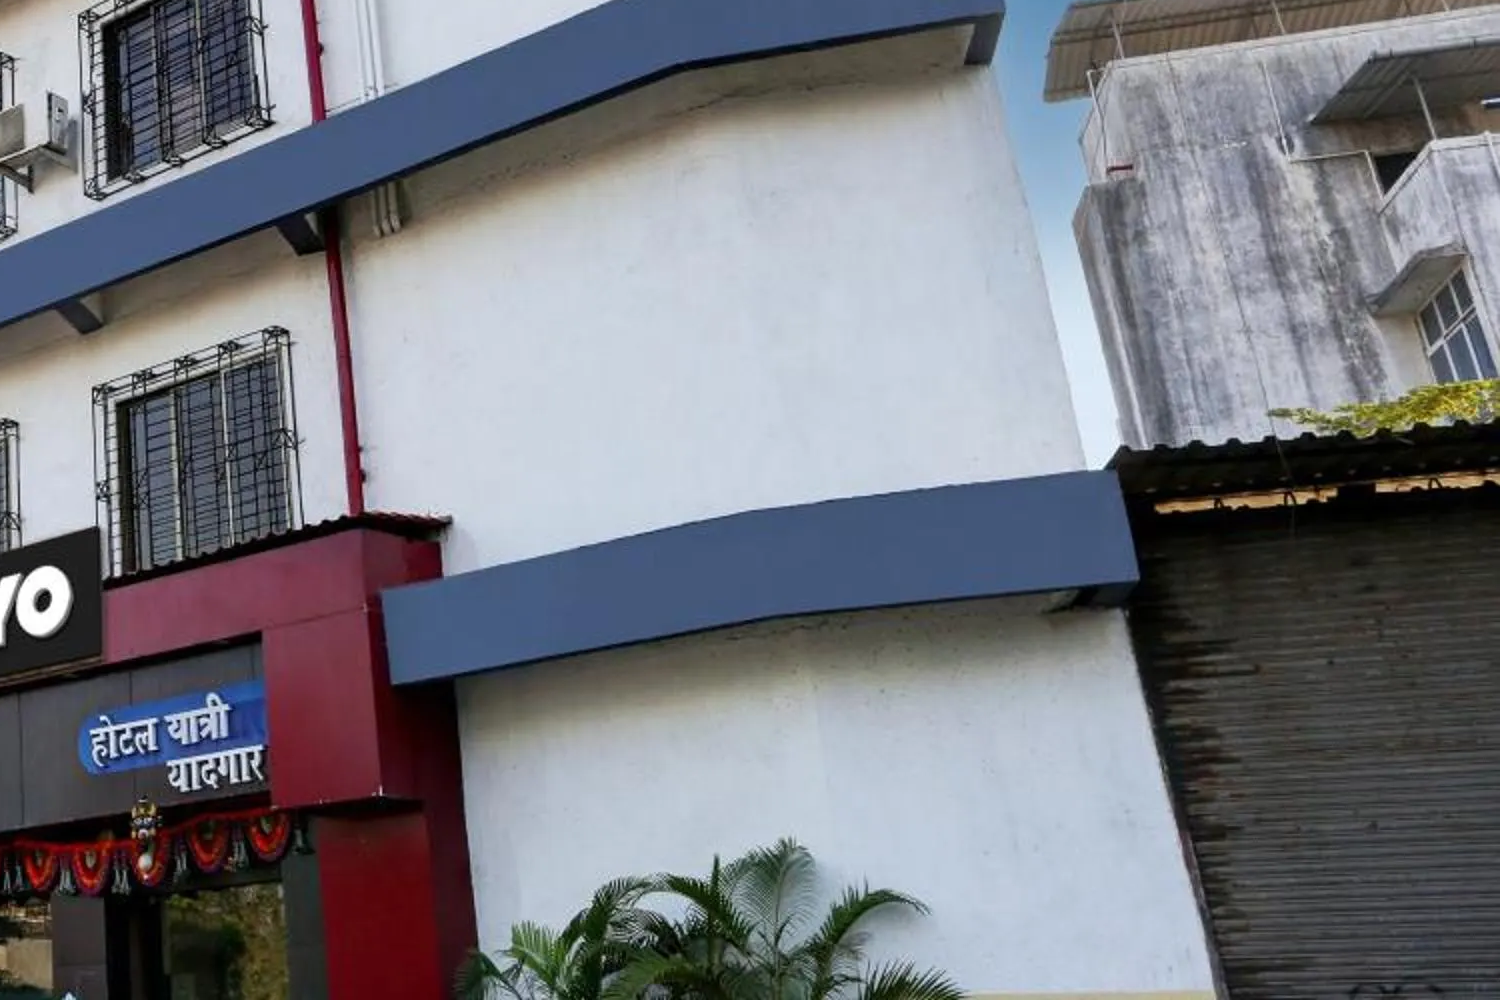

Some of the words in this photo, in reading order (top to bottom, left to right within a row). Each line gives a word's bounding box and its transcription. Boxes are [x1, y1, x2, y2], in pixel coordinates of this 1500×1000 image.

[90, 715, 160, 767] होटल
[164, 692, 232, 745] यात्री
[166, 744, 265, 793] यादगार
